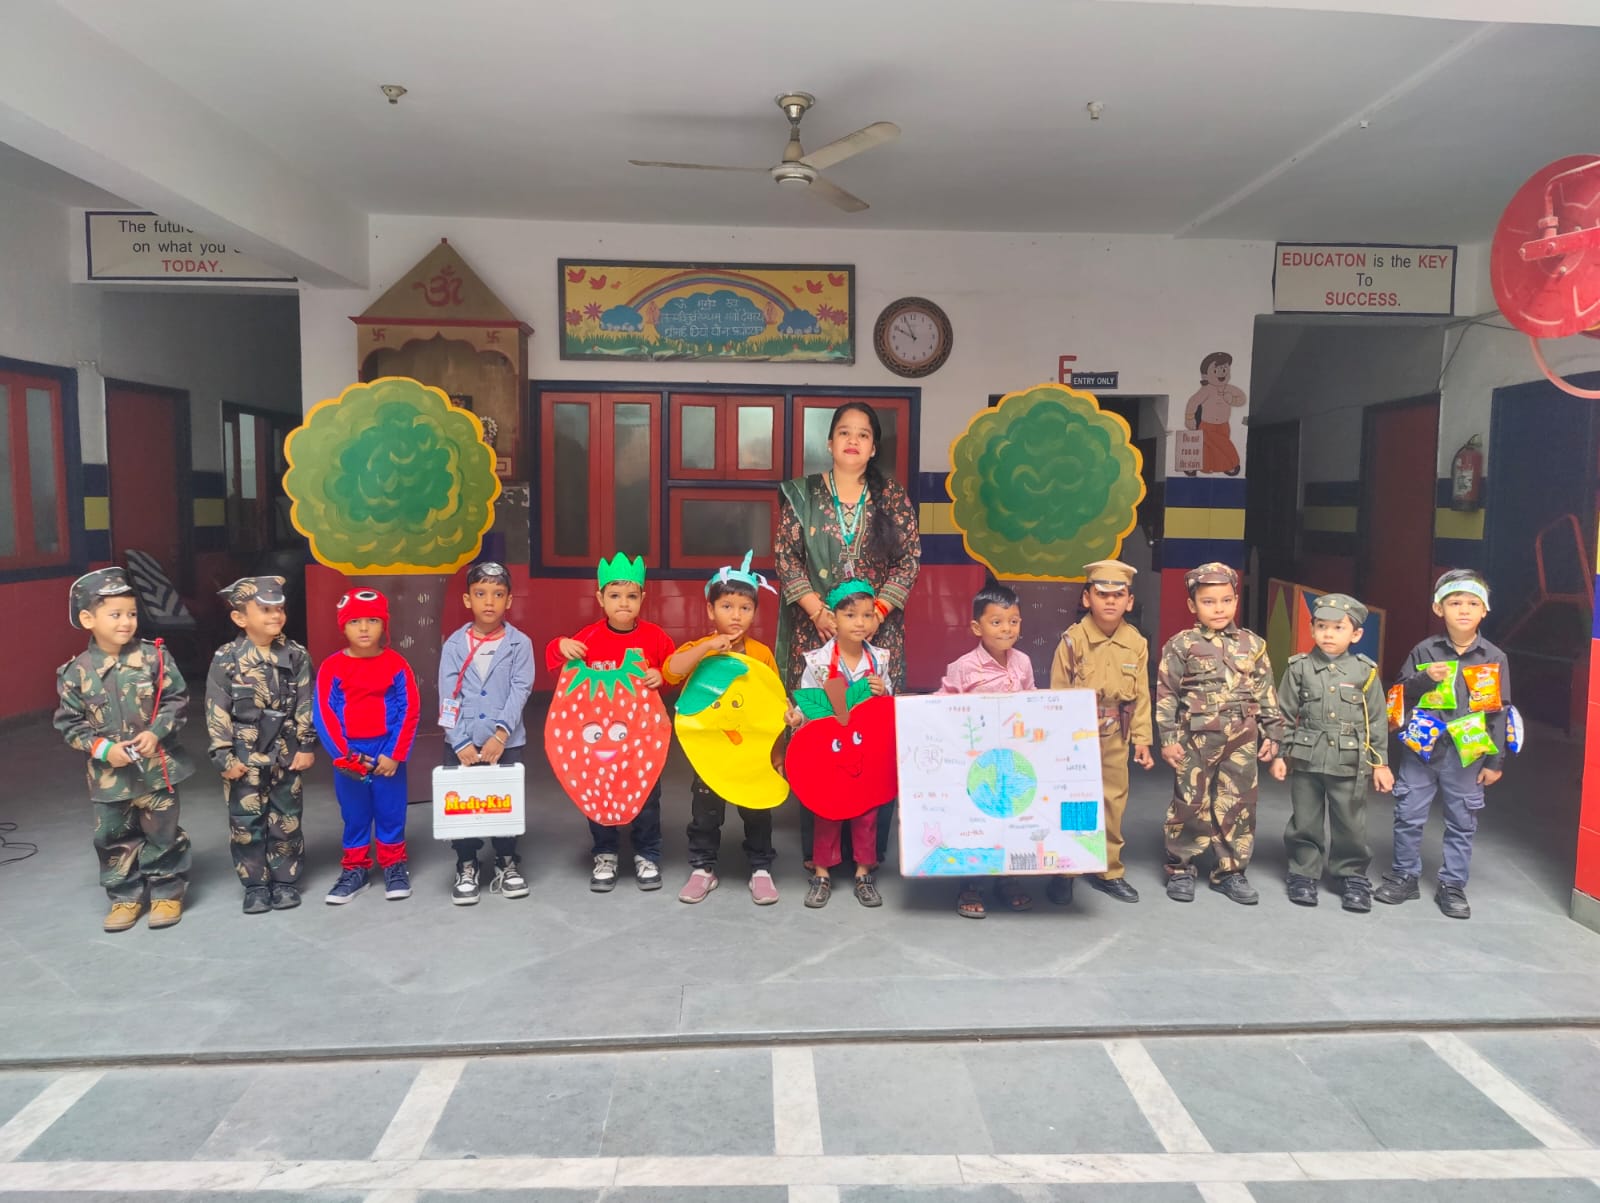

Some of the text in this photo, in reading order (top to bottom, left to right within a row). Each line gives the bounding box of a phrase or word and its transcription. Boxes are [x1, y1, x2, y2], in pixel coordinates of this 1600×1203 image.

[118, 219, 194, 234] The futu
[132, 241, 150, 253] on
[158, 240, 192, 253] what
[200, 243, 226, 256] you
[162, 259, 224, 273] TODAY.
[1281, 252, 1448, 269] EDUCATON is the KEY
[1356, 272, 1373, 287] To
[1325, 291, 1401, 307] SUCCESS.
[1073, 376, 1115, 385] ENTRY ONLY
